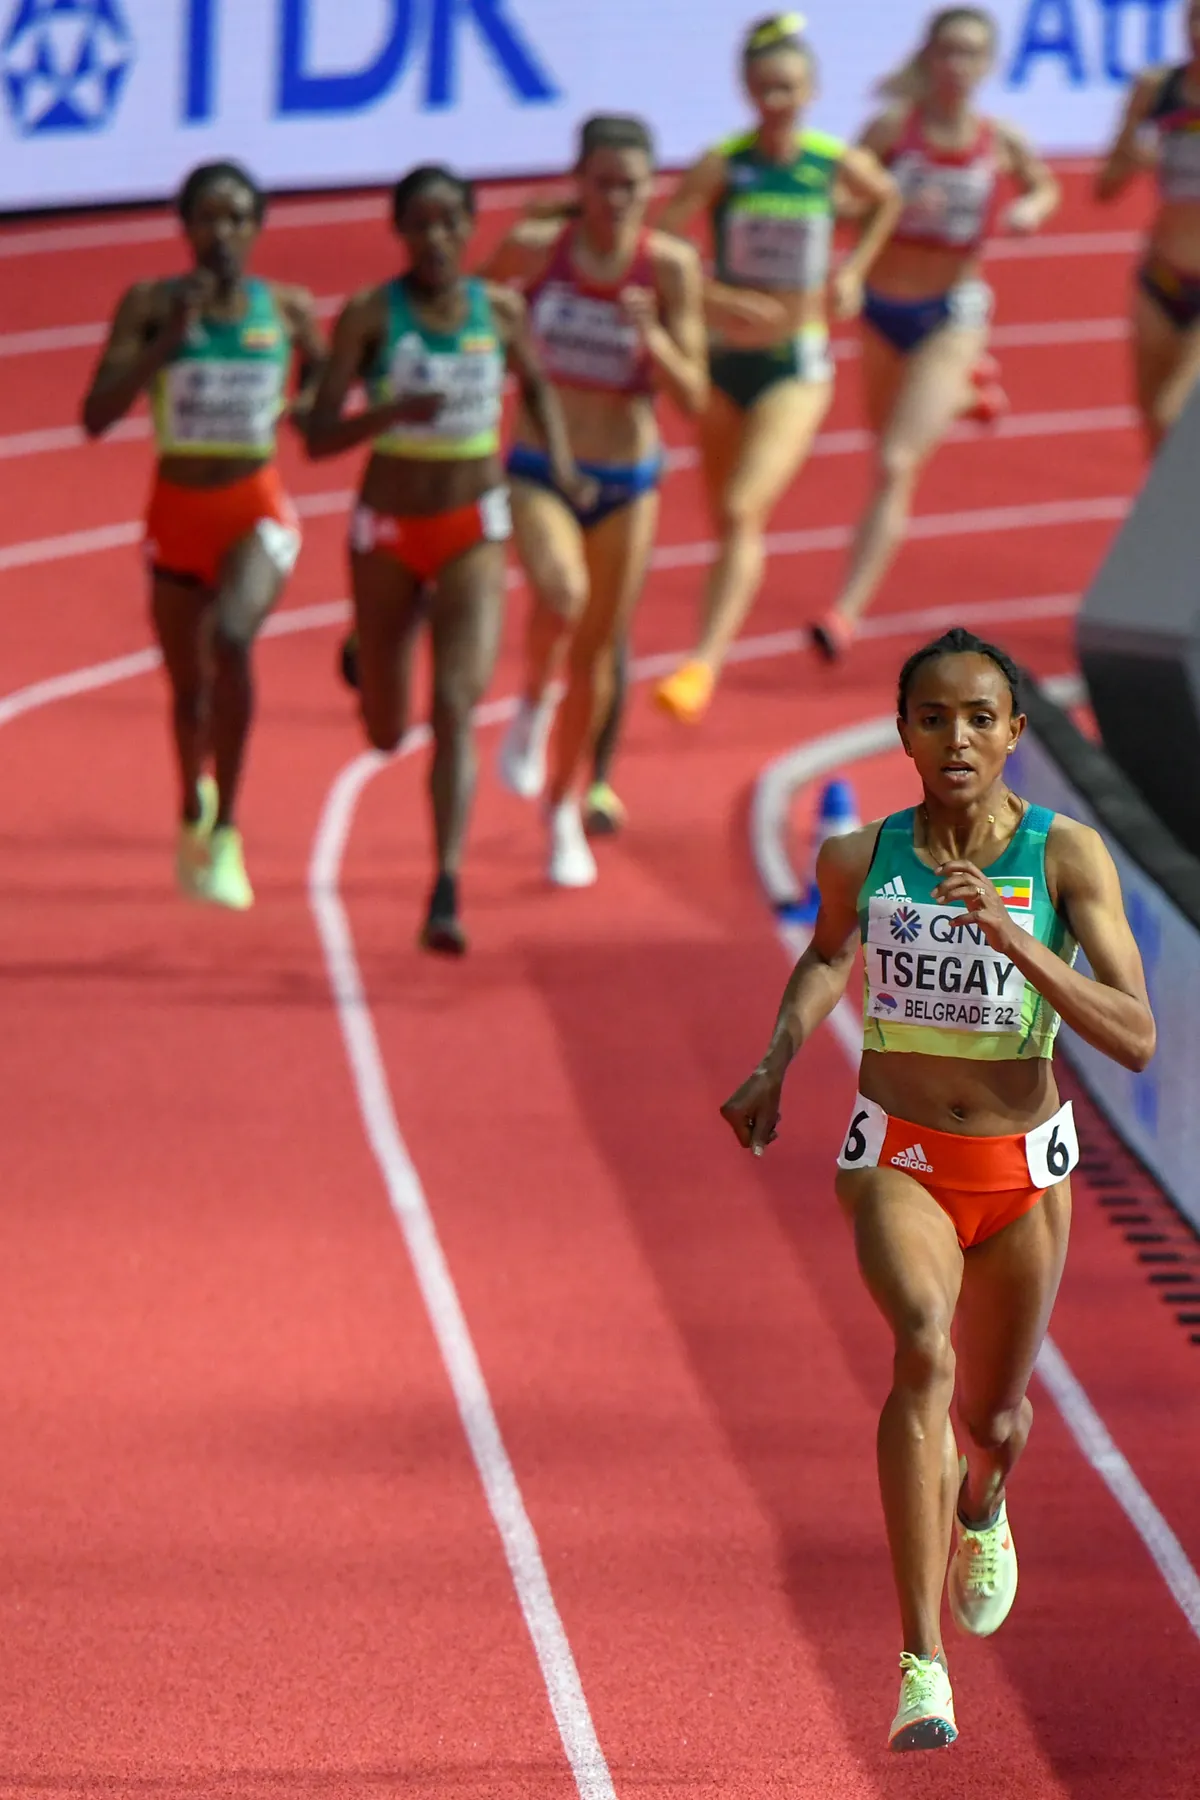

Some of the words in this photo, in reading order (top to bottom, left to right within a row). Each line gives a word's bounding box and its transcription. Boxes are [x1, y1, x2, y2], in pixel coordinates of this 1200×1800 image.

[876, 893, 913, 904] didas
[929, 914, 990, 946] QN
[876, 949, 1015, 996] TSEGAY
[904, 999, 991, 1025] BELGRADE
[994, 1007, 1015, 1025] 22
[844, 1110, 870, 1162] 6
[1046, 1124, 1070, 1177] 6
[890, 1156, 934, 1173] adidas
